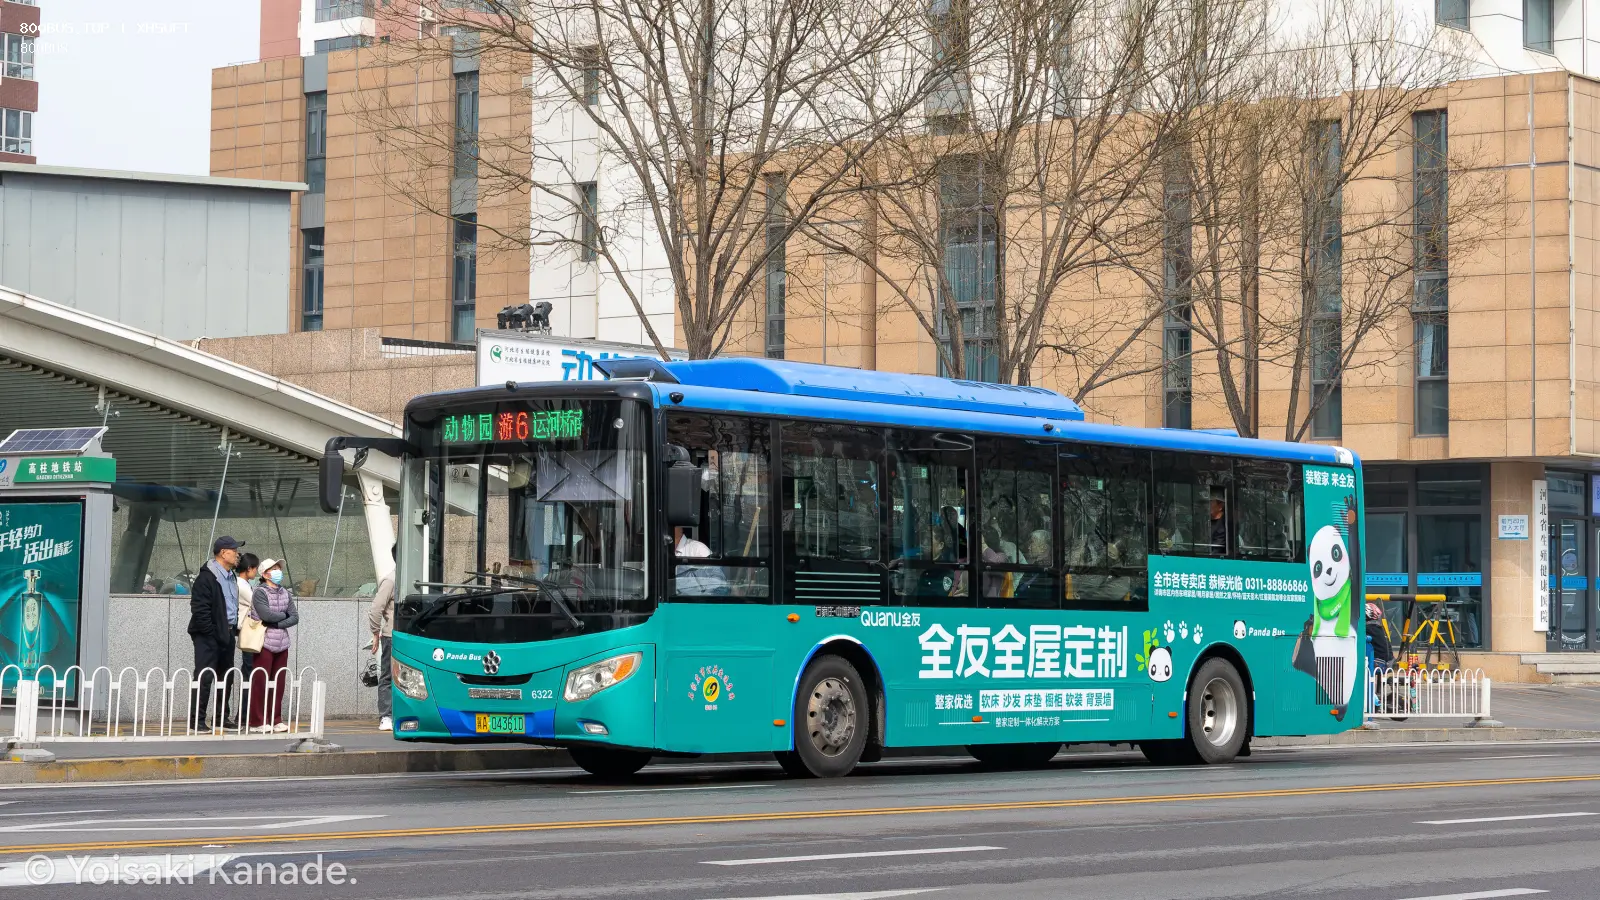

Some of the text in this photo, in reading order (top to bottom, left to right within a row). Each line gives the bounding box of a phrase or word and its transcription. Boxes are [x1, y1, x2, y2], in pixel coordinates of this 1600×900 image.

[444, 413, 493, 442] 动物园
[499, 411, 529, 441] 游6
[28, 461, 82, 474] 高柱地铁站
[1153, 571, 1308, 592] 全市各专卖店 恭候光临 0311-88866866
[1248, 627, 1286, 637] Panda Bus
[446, 652, 482, 662] Panda Bus
[918, 623, 1128, 679] 全友全屋定制
[531, 690, 553, 700] 6322
[935, 694, 973, 710] 整家优选
[981, 693, 1000, 709] 软床
[1002, 693, 1021, 709] 沙发
[1023, 693, 1042, 708] 床垫
[1065, 692, 1083, 708] 软装
[1086, 692, 1112, 707] 背景墙
[995, 716, 1061, 728] 整家定制一体化解决方案
